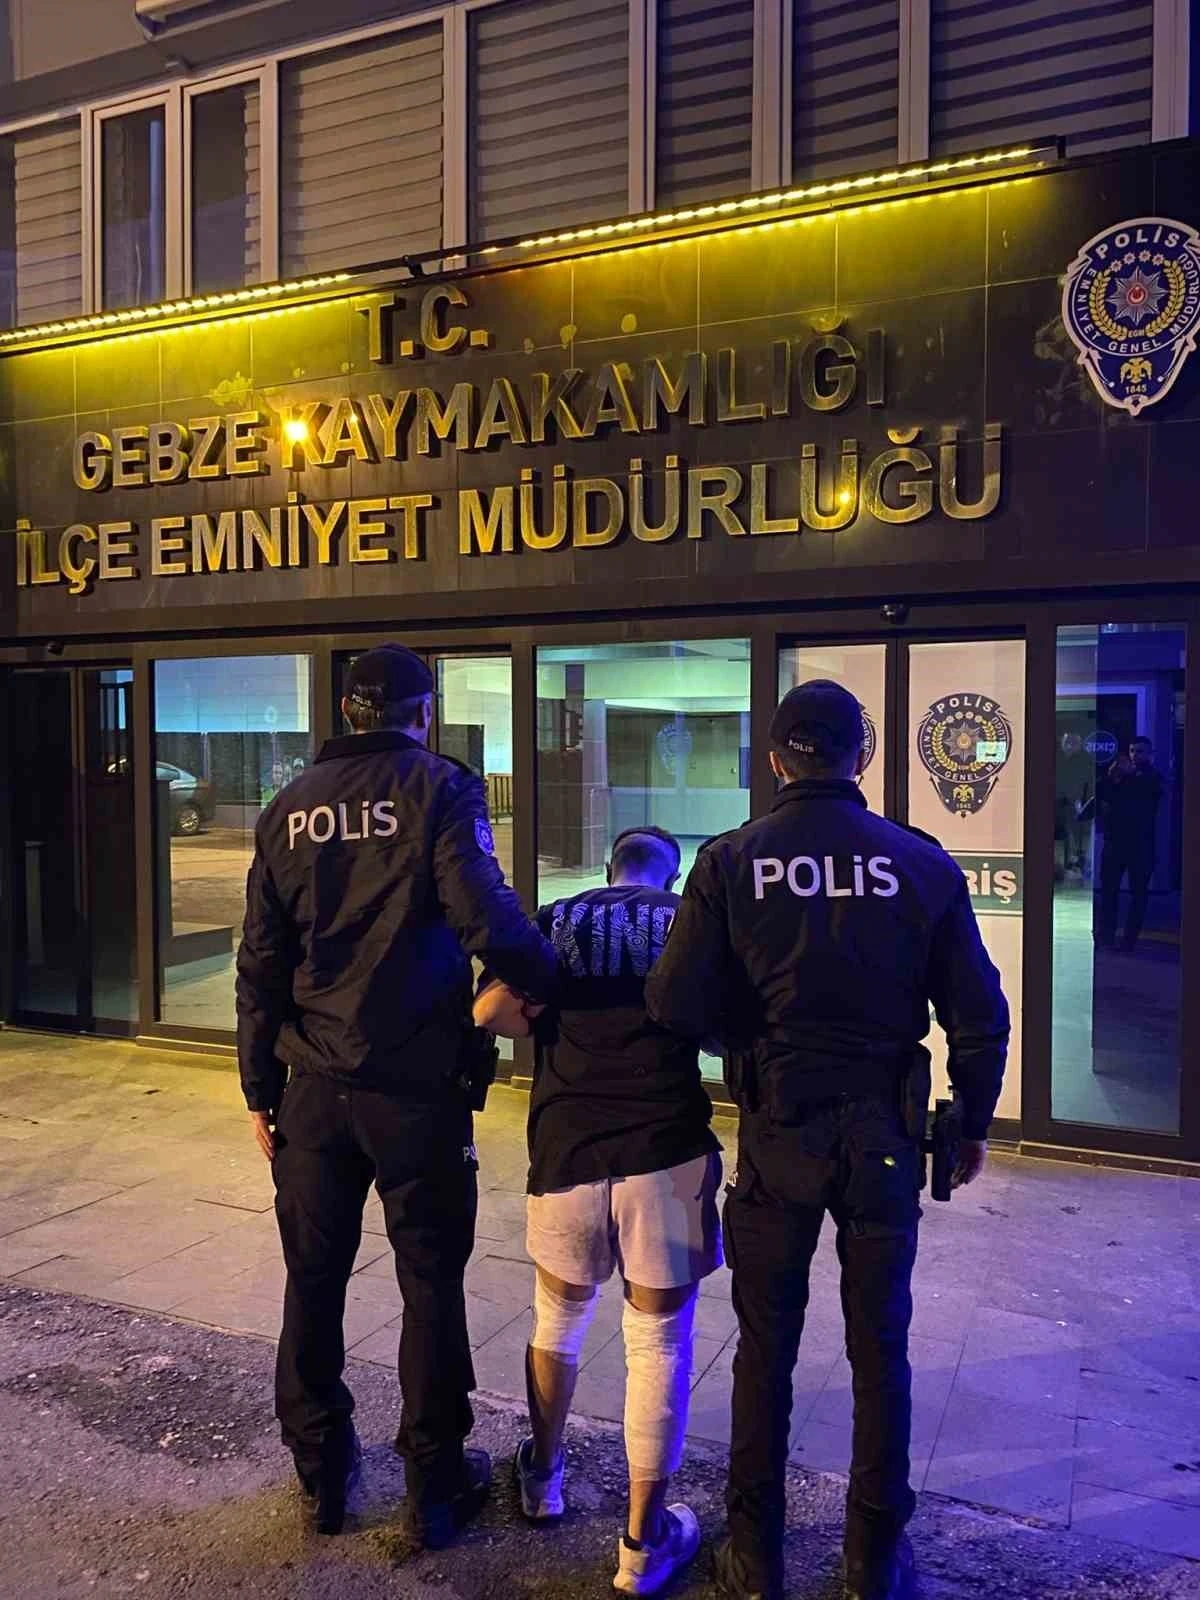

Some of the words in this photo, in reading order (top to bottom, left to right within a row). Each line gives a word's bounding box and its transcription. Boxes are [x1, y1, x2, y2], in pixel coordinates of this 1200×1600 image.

[354, 285, 488, 362] T.C.
[1108, 339, 1161, 353] GENEL
[73, 410, 265, 491] GEBZE
[281, 313, 886, 469] KAYMAKAMLIĞI
[16, 517, 136, 594] İLÇE
[152, 491, 434, 576] EMNİYET
[458, 423, 1003, 555] MÜDÜRLÜĞÜ
